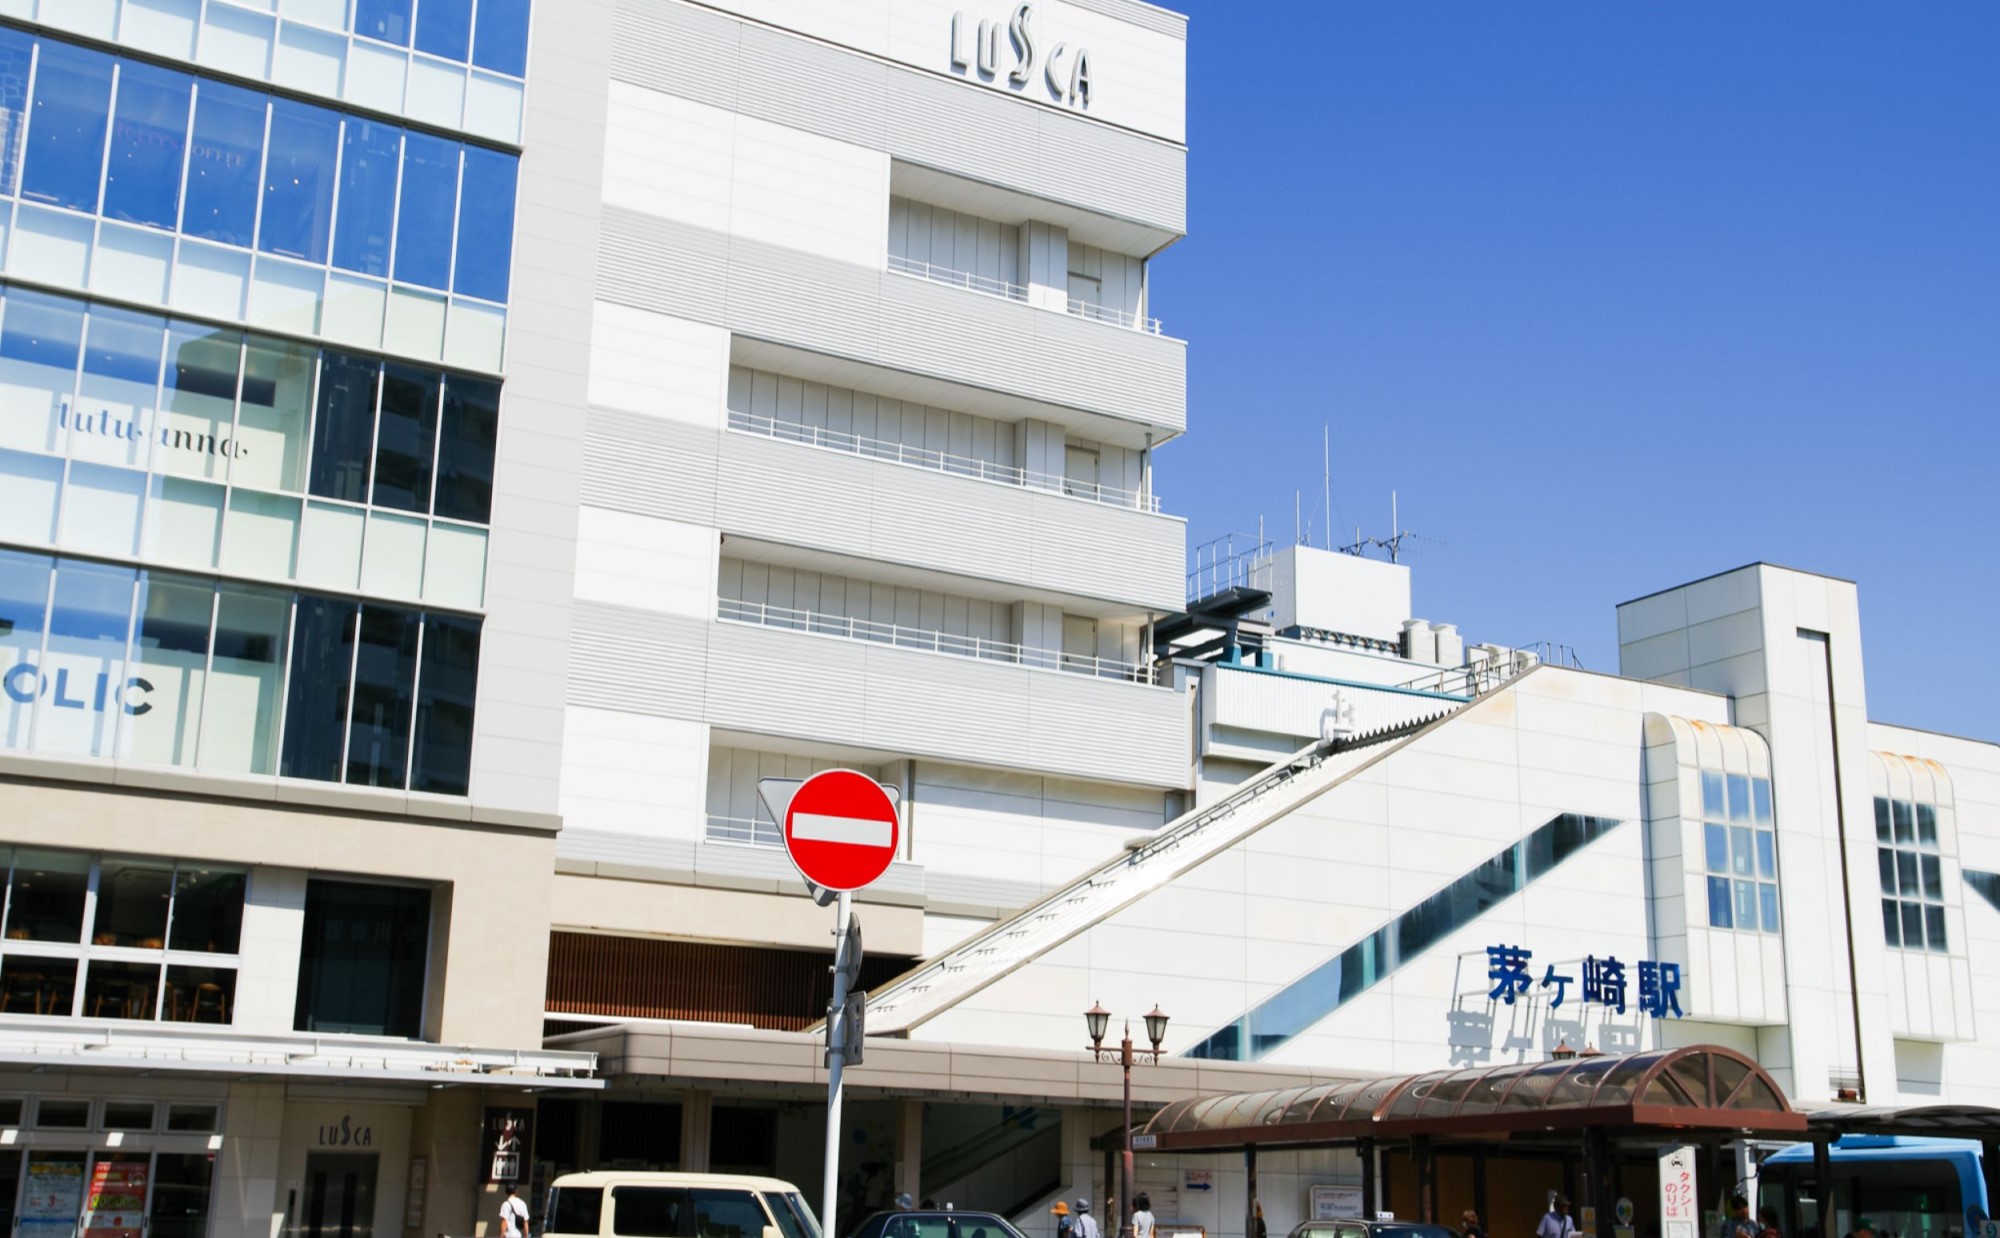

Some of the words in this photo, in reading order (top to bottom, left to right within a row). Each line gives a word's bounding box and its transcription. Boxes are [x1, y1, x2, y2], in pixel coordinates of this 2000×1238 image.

[951, 2, 1093, 105] LUSCA
[182, 143, 246, 168] OFFEE
[1486, 943, 1684, 1019] 茅ヶ崎駅
[319, 1115, 371, 1147] LUSCA
[1680, 1170, 1692, 1218] タクシー
